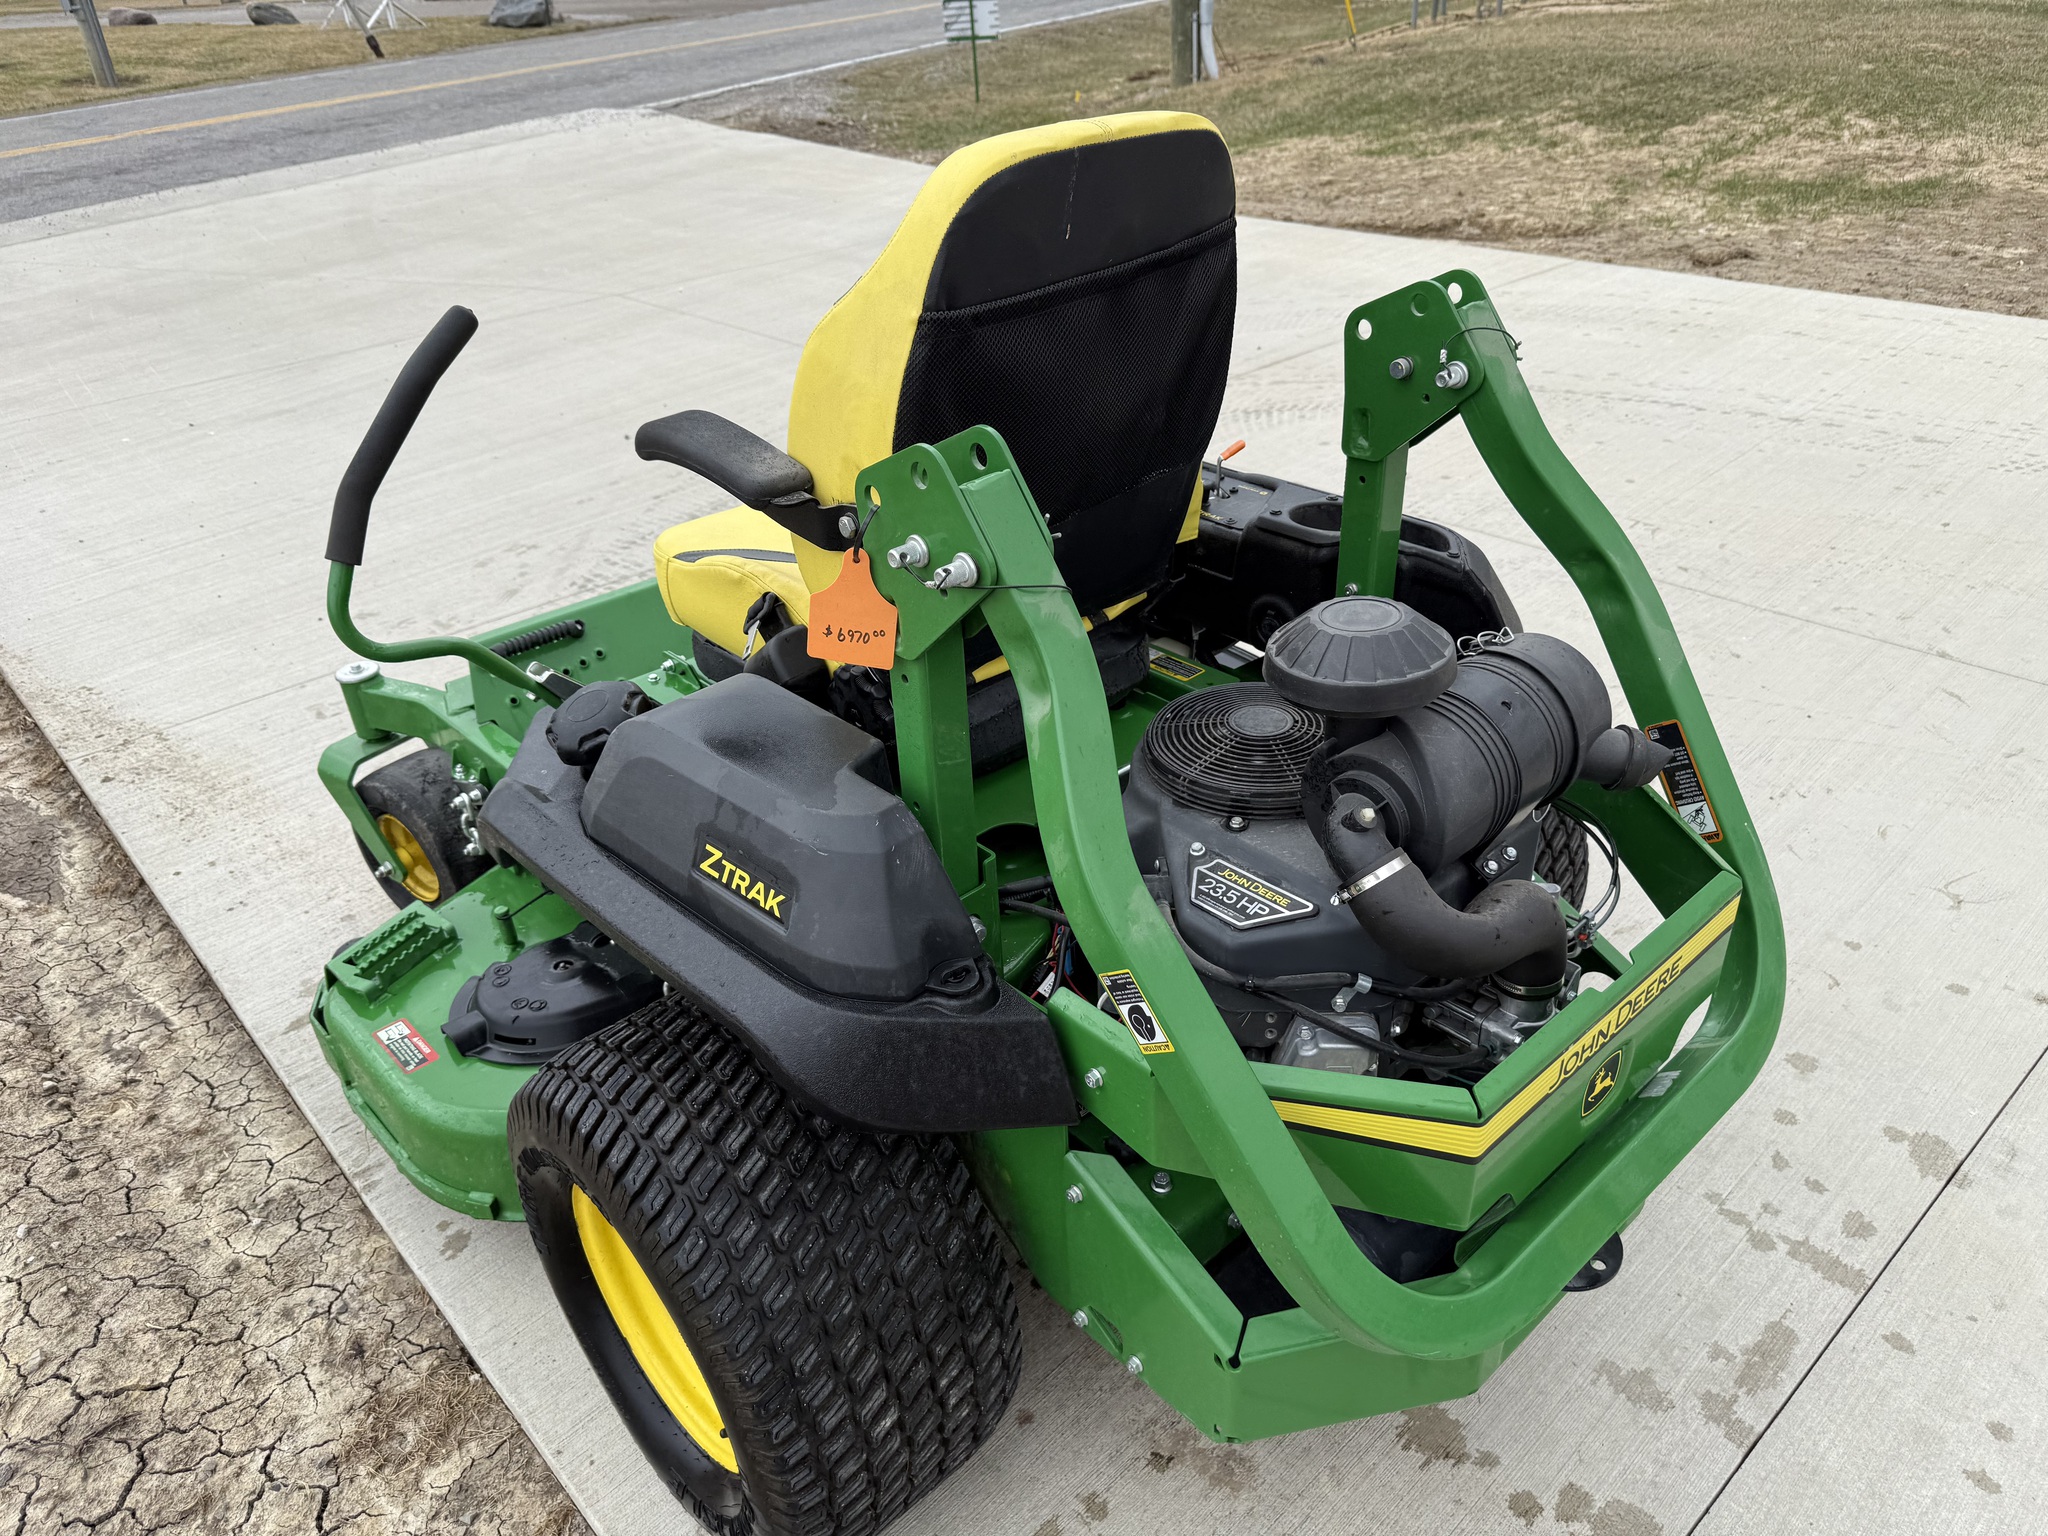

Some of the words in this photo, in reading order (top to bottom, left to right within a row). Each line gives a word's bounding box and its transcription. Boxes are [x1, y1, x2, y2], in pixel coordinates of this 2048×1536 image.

[822, 624, 833, 638] $
[837, 627, 870, 644] 6970
[699, 843, 786, 919] ZTRAK
[1198, 878, 1241, 904] 23.5
[1236, 896, 1270, 915] HP
[1217, 868, 1252, 888] JOHN
[1249, 882, 1291, 907] DEERE
[1549, 1019, 1612, 1093] JOHN
[1614, 954, 1684, 1030] DEERE
